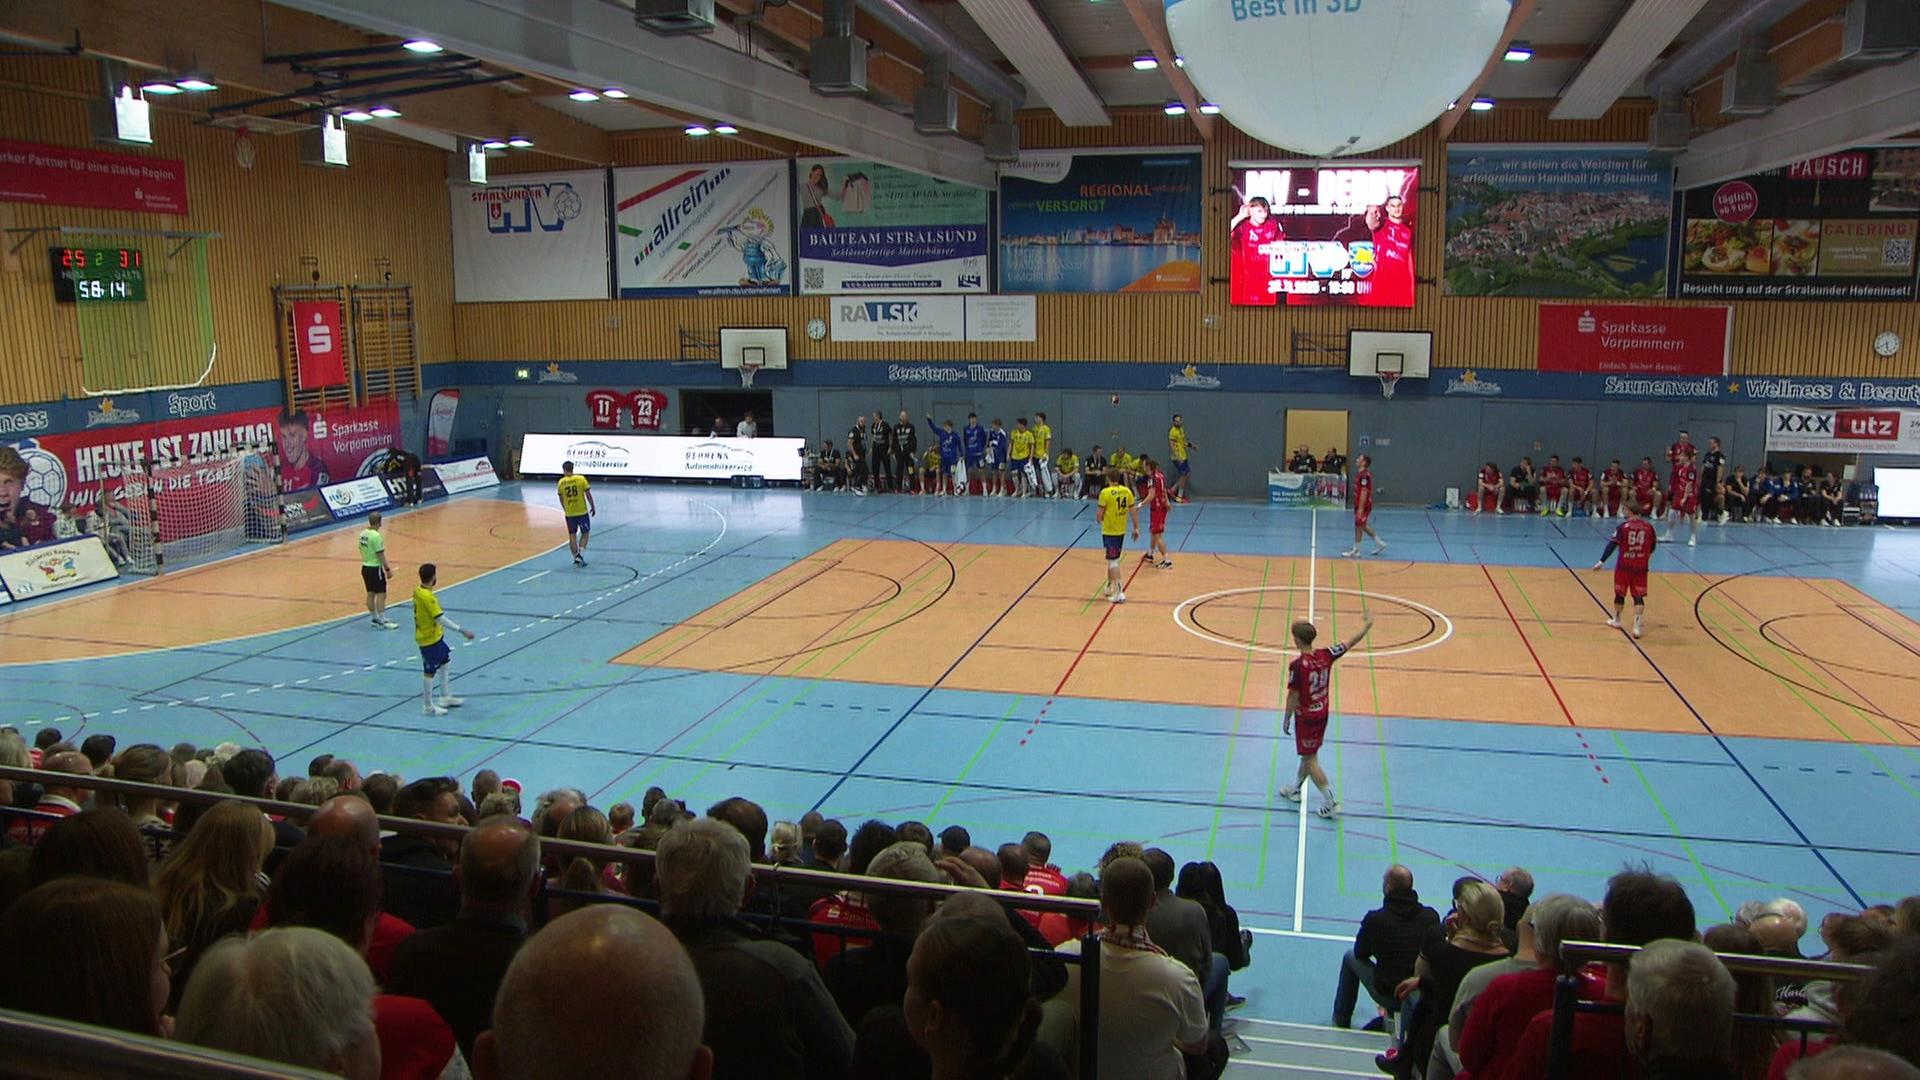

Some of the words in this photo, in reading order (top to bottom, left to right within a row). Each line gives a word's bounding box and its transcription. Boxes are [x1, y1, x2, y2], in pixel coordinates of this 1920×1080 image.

[1231, 0, 1286, 21] Best
[28, 154, 68, 169] Partner
[70, 157, 86, 171] für
[87, 160, 109, 172] eine
[110, 162, 140, 177] starke
[142, 166, 177, 181] Region.
[1502, 159, 1518, 170] wir
[1521, 159, 1559, 170] stellen
[1561, 159, 1578, 170] die
[1581, 159, 1630, 170] Weichen
[1632, 159, 1648, 170] für
[1790, 157, 1863, 177] PAUSCH
[1462, 172, 1536, 186] erfolgreichen
[1538, 172, 1587, 184] Handball
[1590, 172, 1600, 184] in
[1602, 171, 1659, 184] Stralsund
[471, 189, 543, 203] STRALSUNDER
[1079, 183, 1153, 198] REGIONAL
[1717, 190, 1753, 206] täglich
[653, 178, 710, 246] allrein
[1035, 199, 1107, 213] VERSORGT
[1738, 202, 1752, 213] Uhr
[1824, 223, 1914, 236] CATERING!
[809, 232, 881, 246] BAUTEAM
[886, 230, 978, 245] STRALSUND
[62, 248, 86, 268] 25
[119, 248, 141, 269] 31
[1682, 282, 1724, 295] Besucht
[1725, 284, 1744, 295] uns
[1746, 283, 1763, 295] auf
[1764, 283, 1782, 295] der
[1784, 283, 1847, 296] Stralsunder
[1849, 284, 1912, 297] Hafeninsel!
[1601, 320, 1666, 336] Sparkasse
[1600, 336, 1685, 351] Vorpommern
[1604, 376, 1719, 398] Saunenwelt
[1744, 379, 1834, 400] Wellness
[1838, 382, 1856, 400] &
[167, 390, 217, 418] Sport
[598, 399, 611, 416] 11
[637, 399, 653, 417] 23
[0, 409, 48, 433] ness
[331, 420, 380, 439] Sparkasse
[332, 434, 393, 454] Vorpommern
[75, 440, 145, 483] HEUTE
[150, 435, 183, 471] IST
[685, 451, 730, 460] BEHRENS
[170, 474, 192, 490] DIE
[564, 485, 578, 498] 28
[1115, 496, 1127, 510] 14
